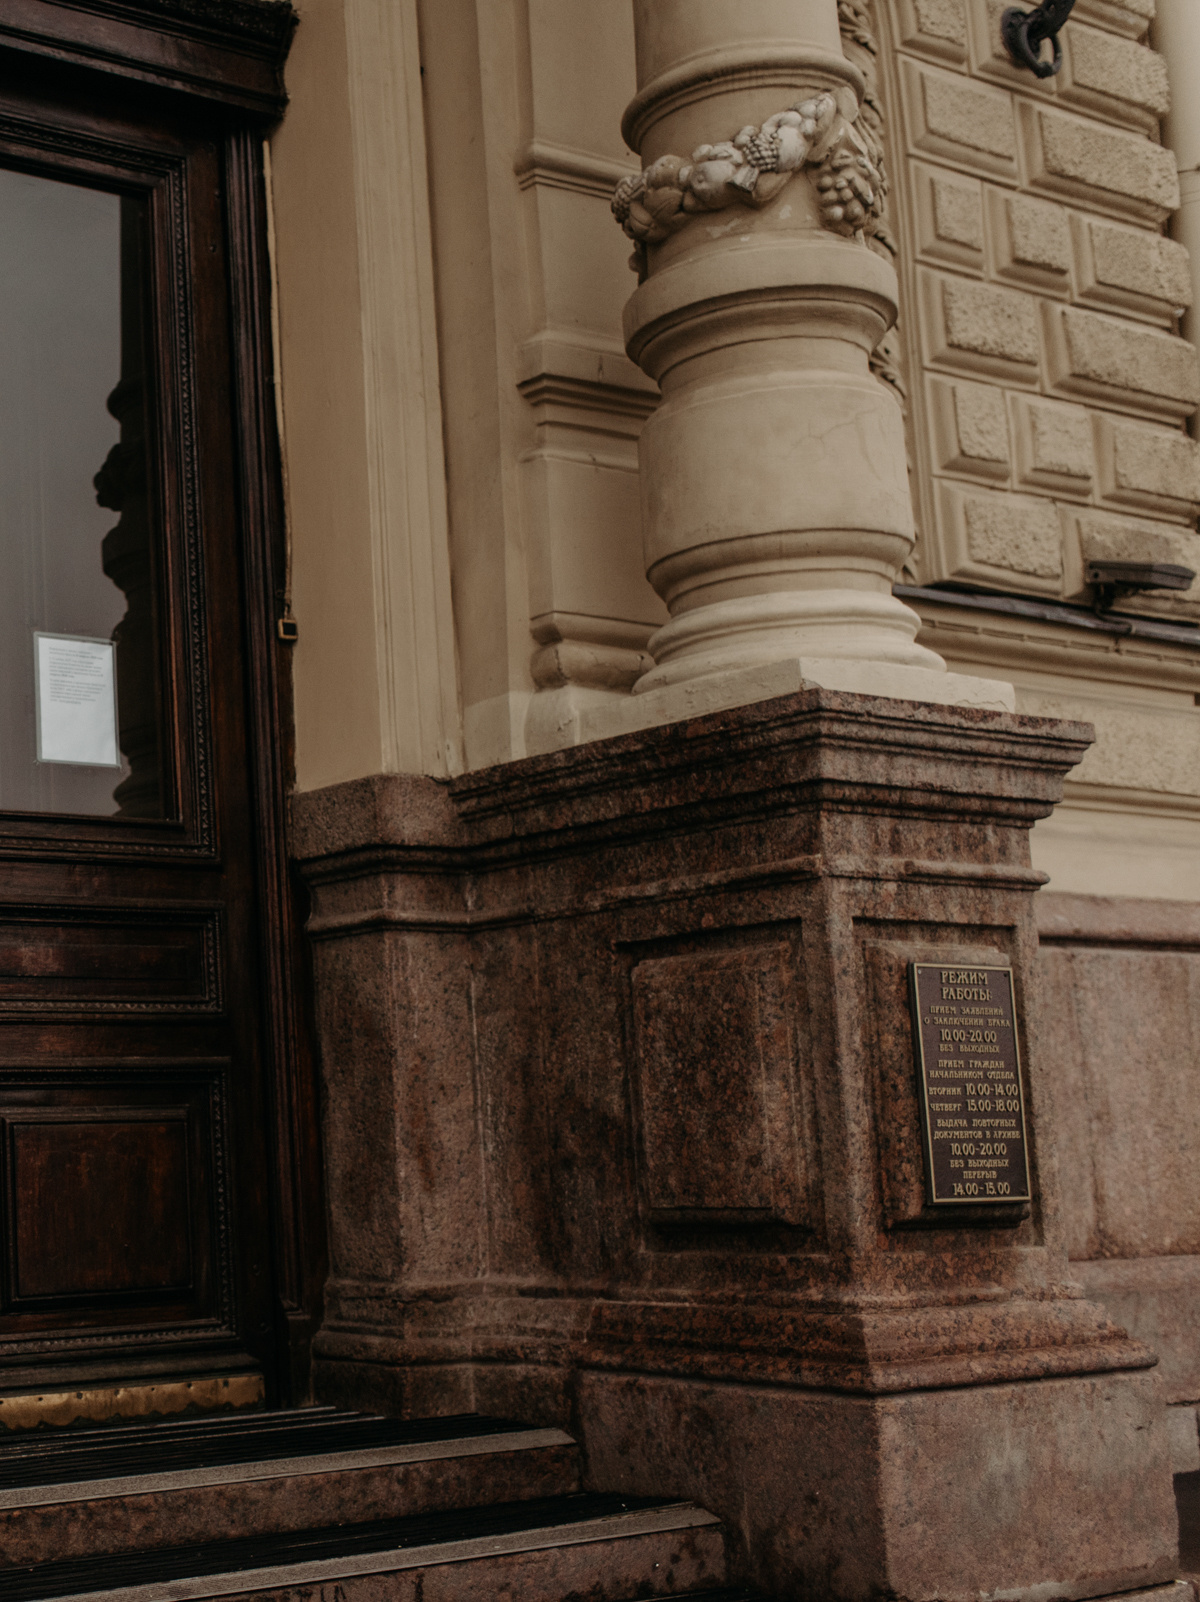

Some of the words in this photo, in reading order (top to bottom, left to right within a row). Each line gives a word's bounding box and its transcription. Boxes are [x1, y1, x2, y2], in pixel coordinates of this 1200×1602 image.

[941, 971, 988, 984] РЕЖИМ
[941, 987, 993, 1001] РАБОТЫ:
[930, 1006, 956, 1014] ПРИЕМ
[933, 1017, 984, 1026] ЗАКЛЮЧЕНИИ
[988, 1018, 1011, 1028] БРАКА
[939, 1043, 954, 1053] БЕЗ
[959, 1043, 1000, 1054] ВЫХОДНЫХ
[938, 1059, 965, 1069] ПРИЕМ
[969, 1059, 1005, 1070] ГРАЖДАН
[929, 1069, 984, 1079] НАЧАЛЬНИКОМ
[987, 1070, 1015, 1081] ОТДЕЛА
[928, 1086, 962, 1096] ВТОРНИК
[930, 1102, 962, 1112] ЧЕТВЕРГ
[937, 1118, 968, 1129] ВЫДАЧА
[972, 1118, 1016, 1128] ПОВТОРНЫХ
[933, 1130, 983, 1140] ДОКУМЕНТОВ
[985, 1131, 991, 1139] В
[993, 1130, 1021, 1139] АРХИВЕ
[950, 1159, 965, 1168] БЕЗ
[968, 1159, 1009, 1168] ВЫХОДНЫХ
[963, 1170, 998, 1180] ПЕРЕРЫВ
